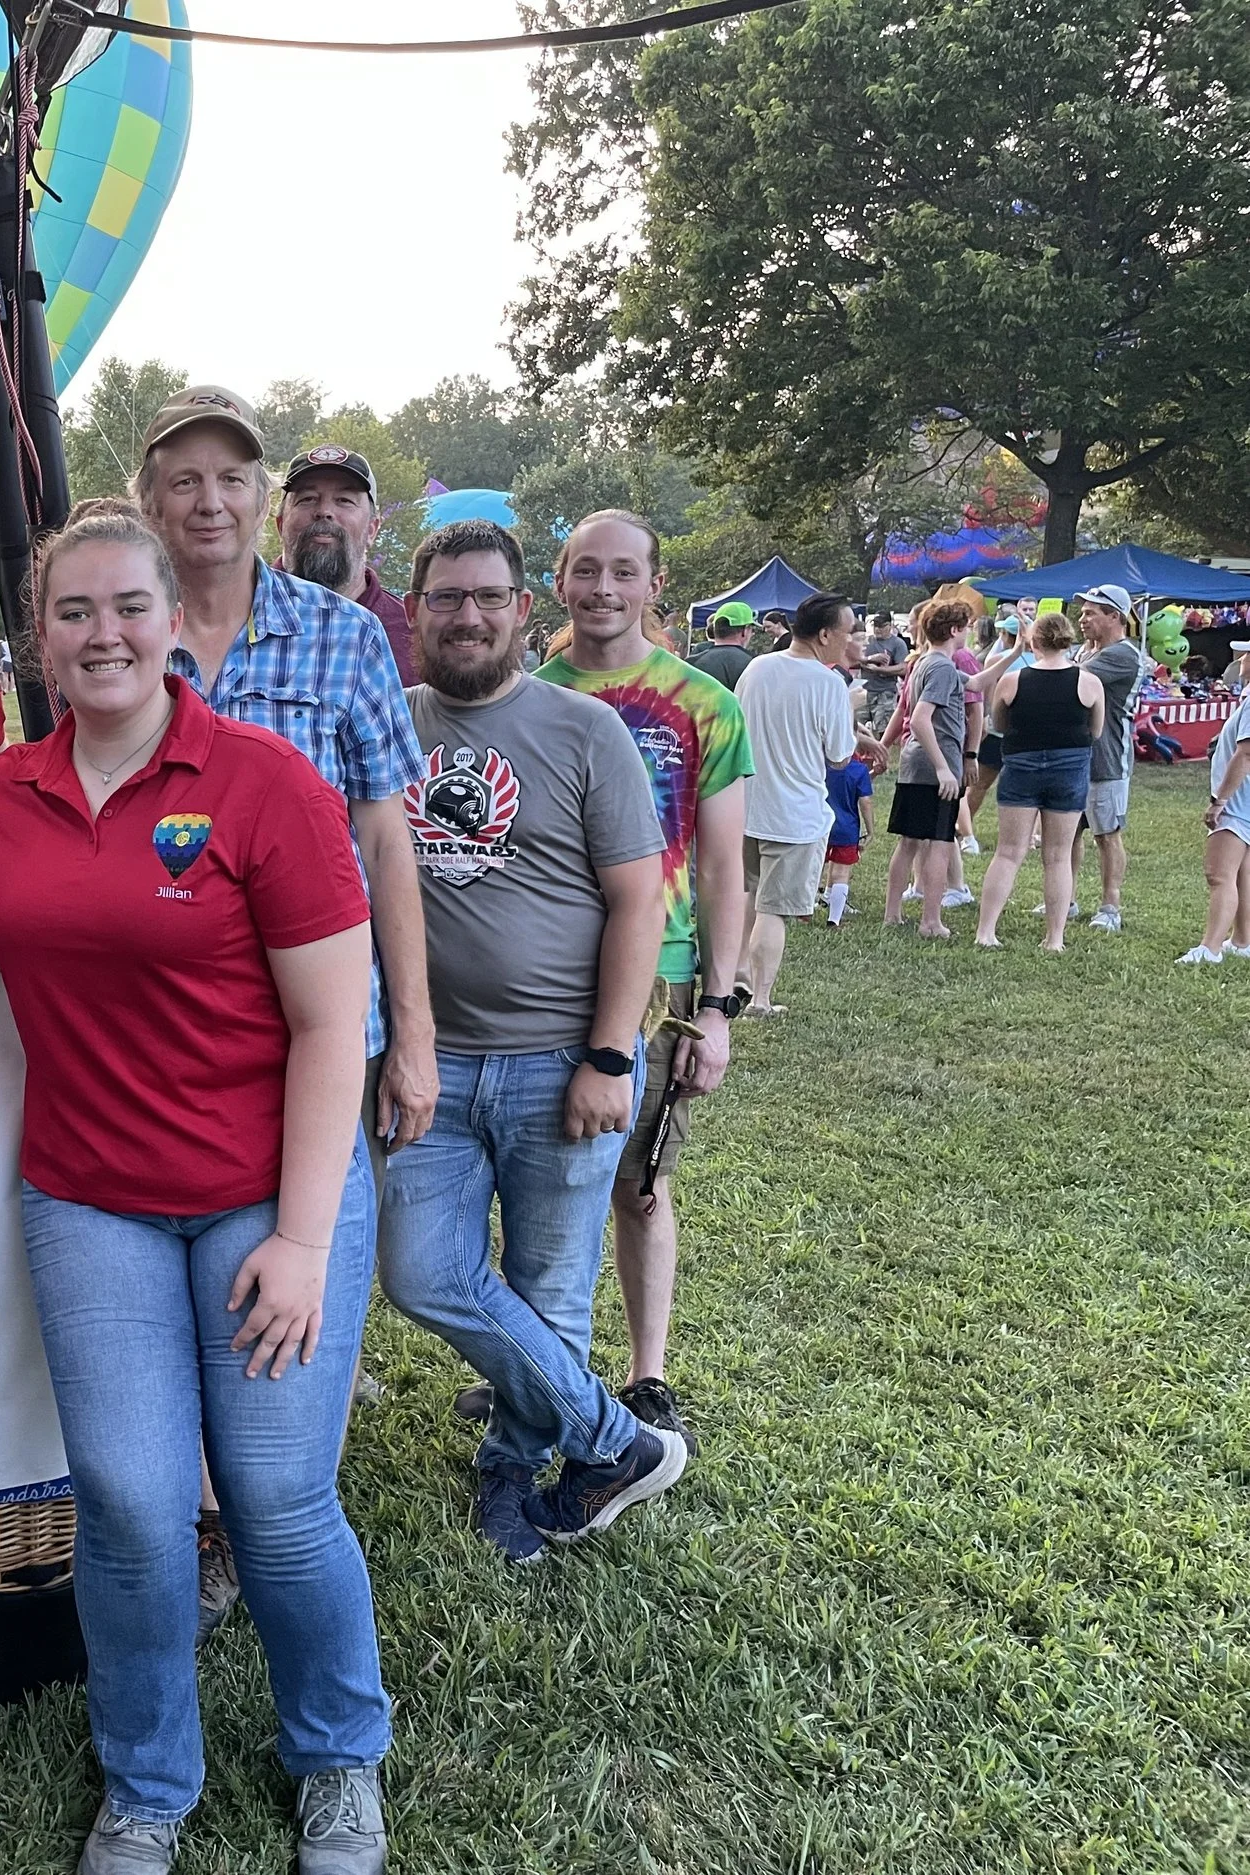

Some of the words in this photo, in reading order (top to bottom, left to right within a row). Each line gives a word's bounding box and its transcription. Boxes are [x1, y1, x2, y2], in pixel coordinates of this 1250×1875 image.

[456, 752, 473, 763] 2017
[458, 842, 517, 858] WARS
[426, 856, 441, 864] DARK
[441, 856, 454, 865] SIDE
[455, 856, 470, 865] HALF
[155, 886, 192, 899] Jillian
